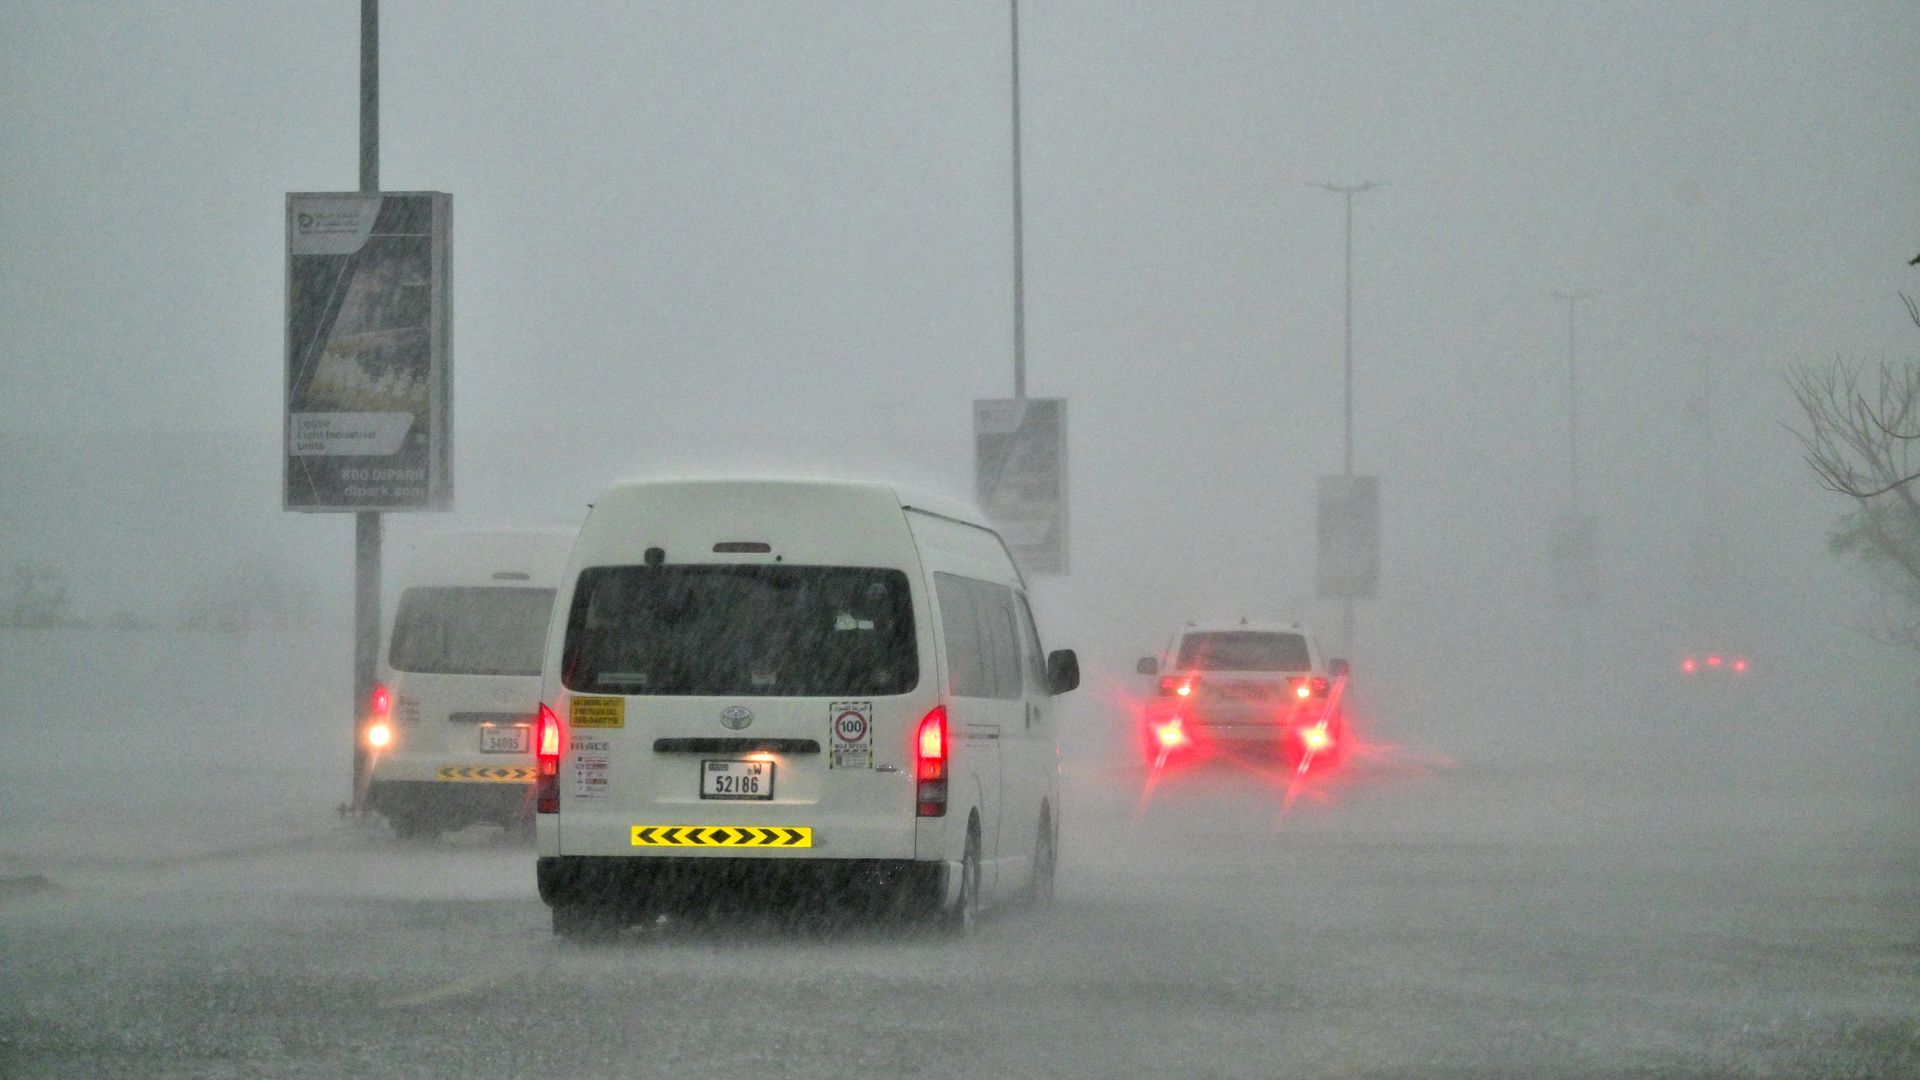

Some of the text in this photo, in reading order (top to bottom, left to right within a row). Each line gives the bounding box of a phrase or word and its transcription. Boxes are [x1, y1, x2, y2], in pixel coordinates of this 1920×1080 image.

[840, 720, 862, 733] 100
[753, 763, 762, 775] W
[716, 776, 759, 793] 52186
